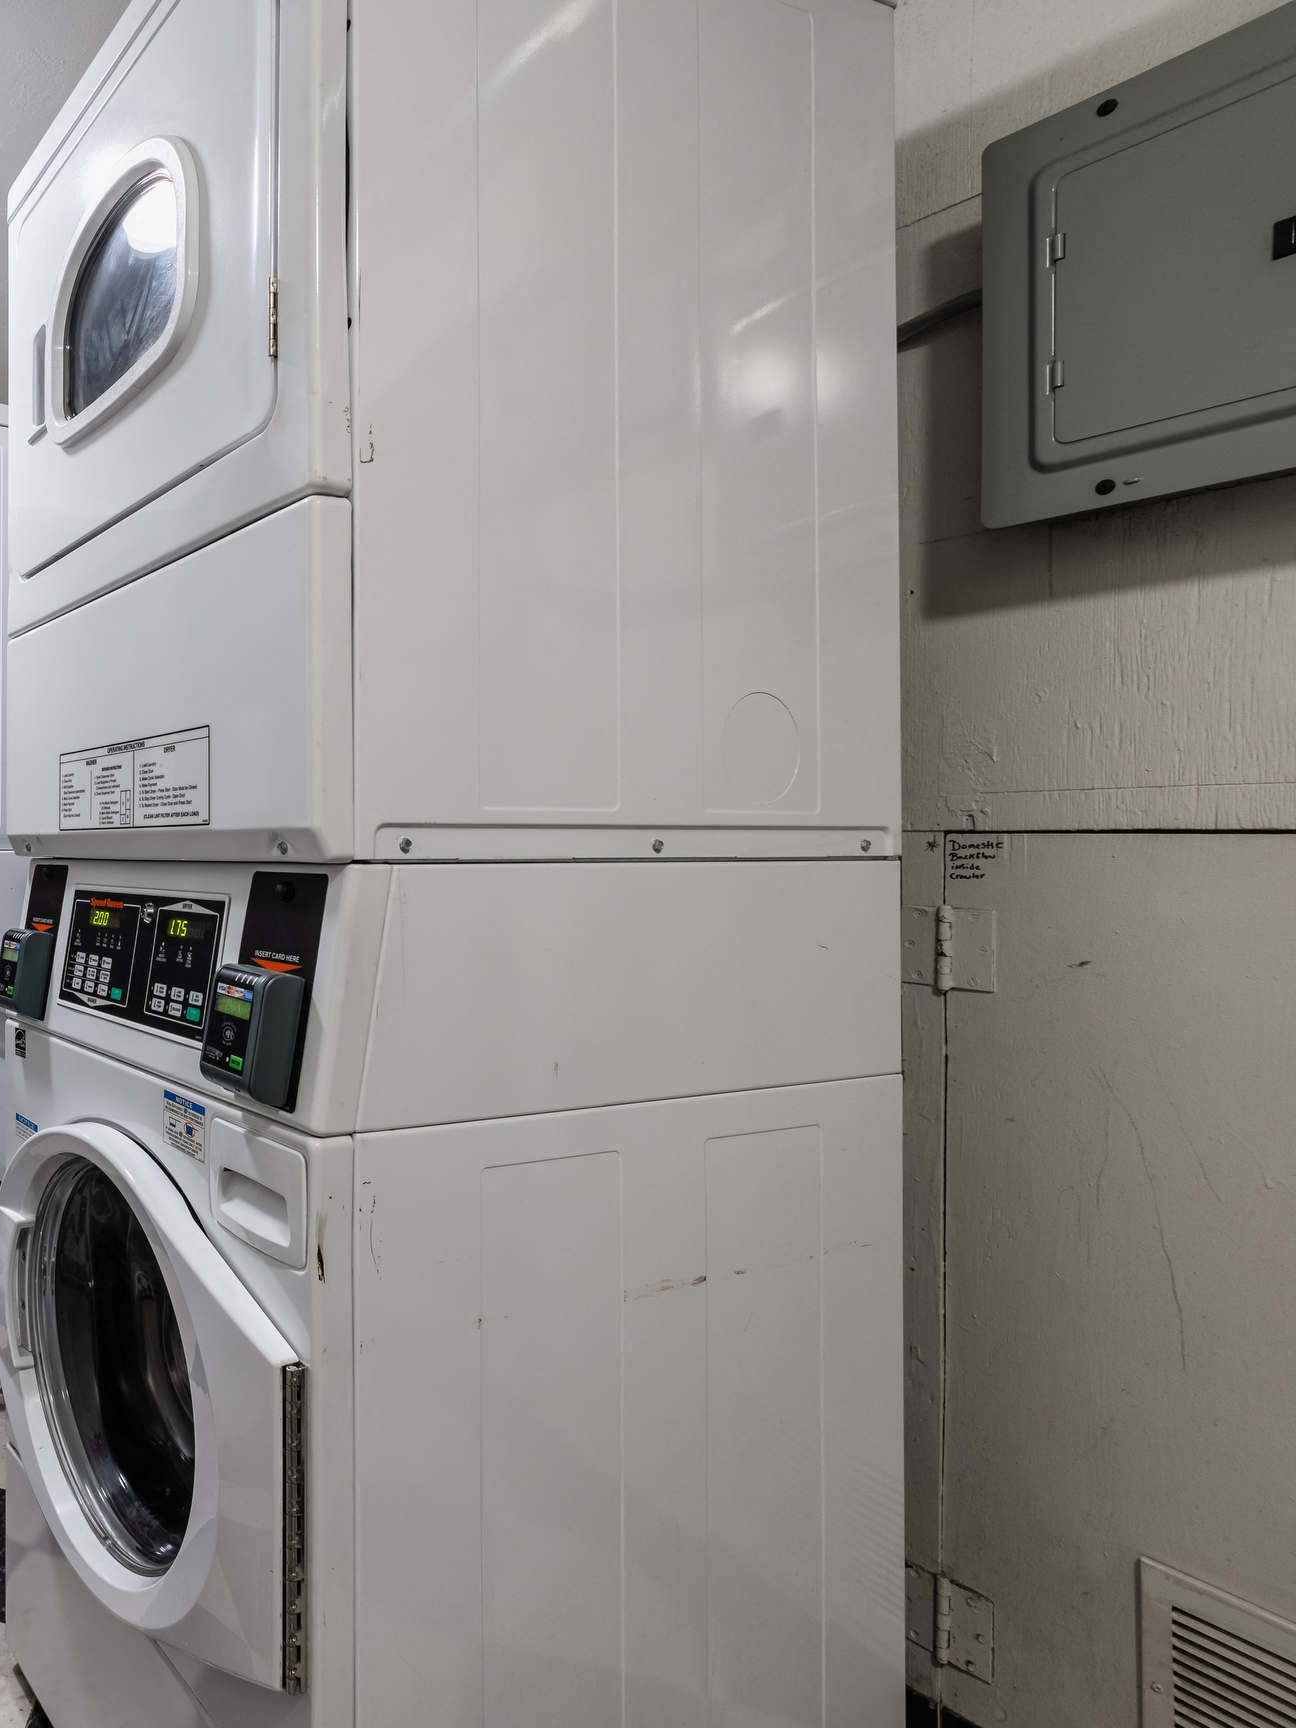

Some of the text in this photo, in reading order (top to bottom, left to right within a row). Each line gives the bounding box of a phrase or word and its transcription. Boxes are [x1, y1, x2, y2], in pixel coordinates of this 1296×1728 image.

[949, 840, 1004, 851] Domestic
[254, 949, 301, 963] INSERT CARD HERE
[175, 1096, 193, 1109] NOTICE
